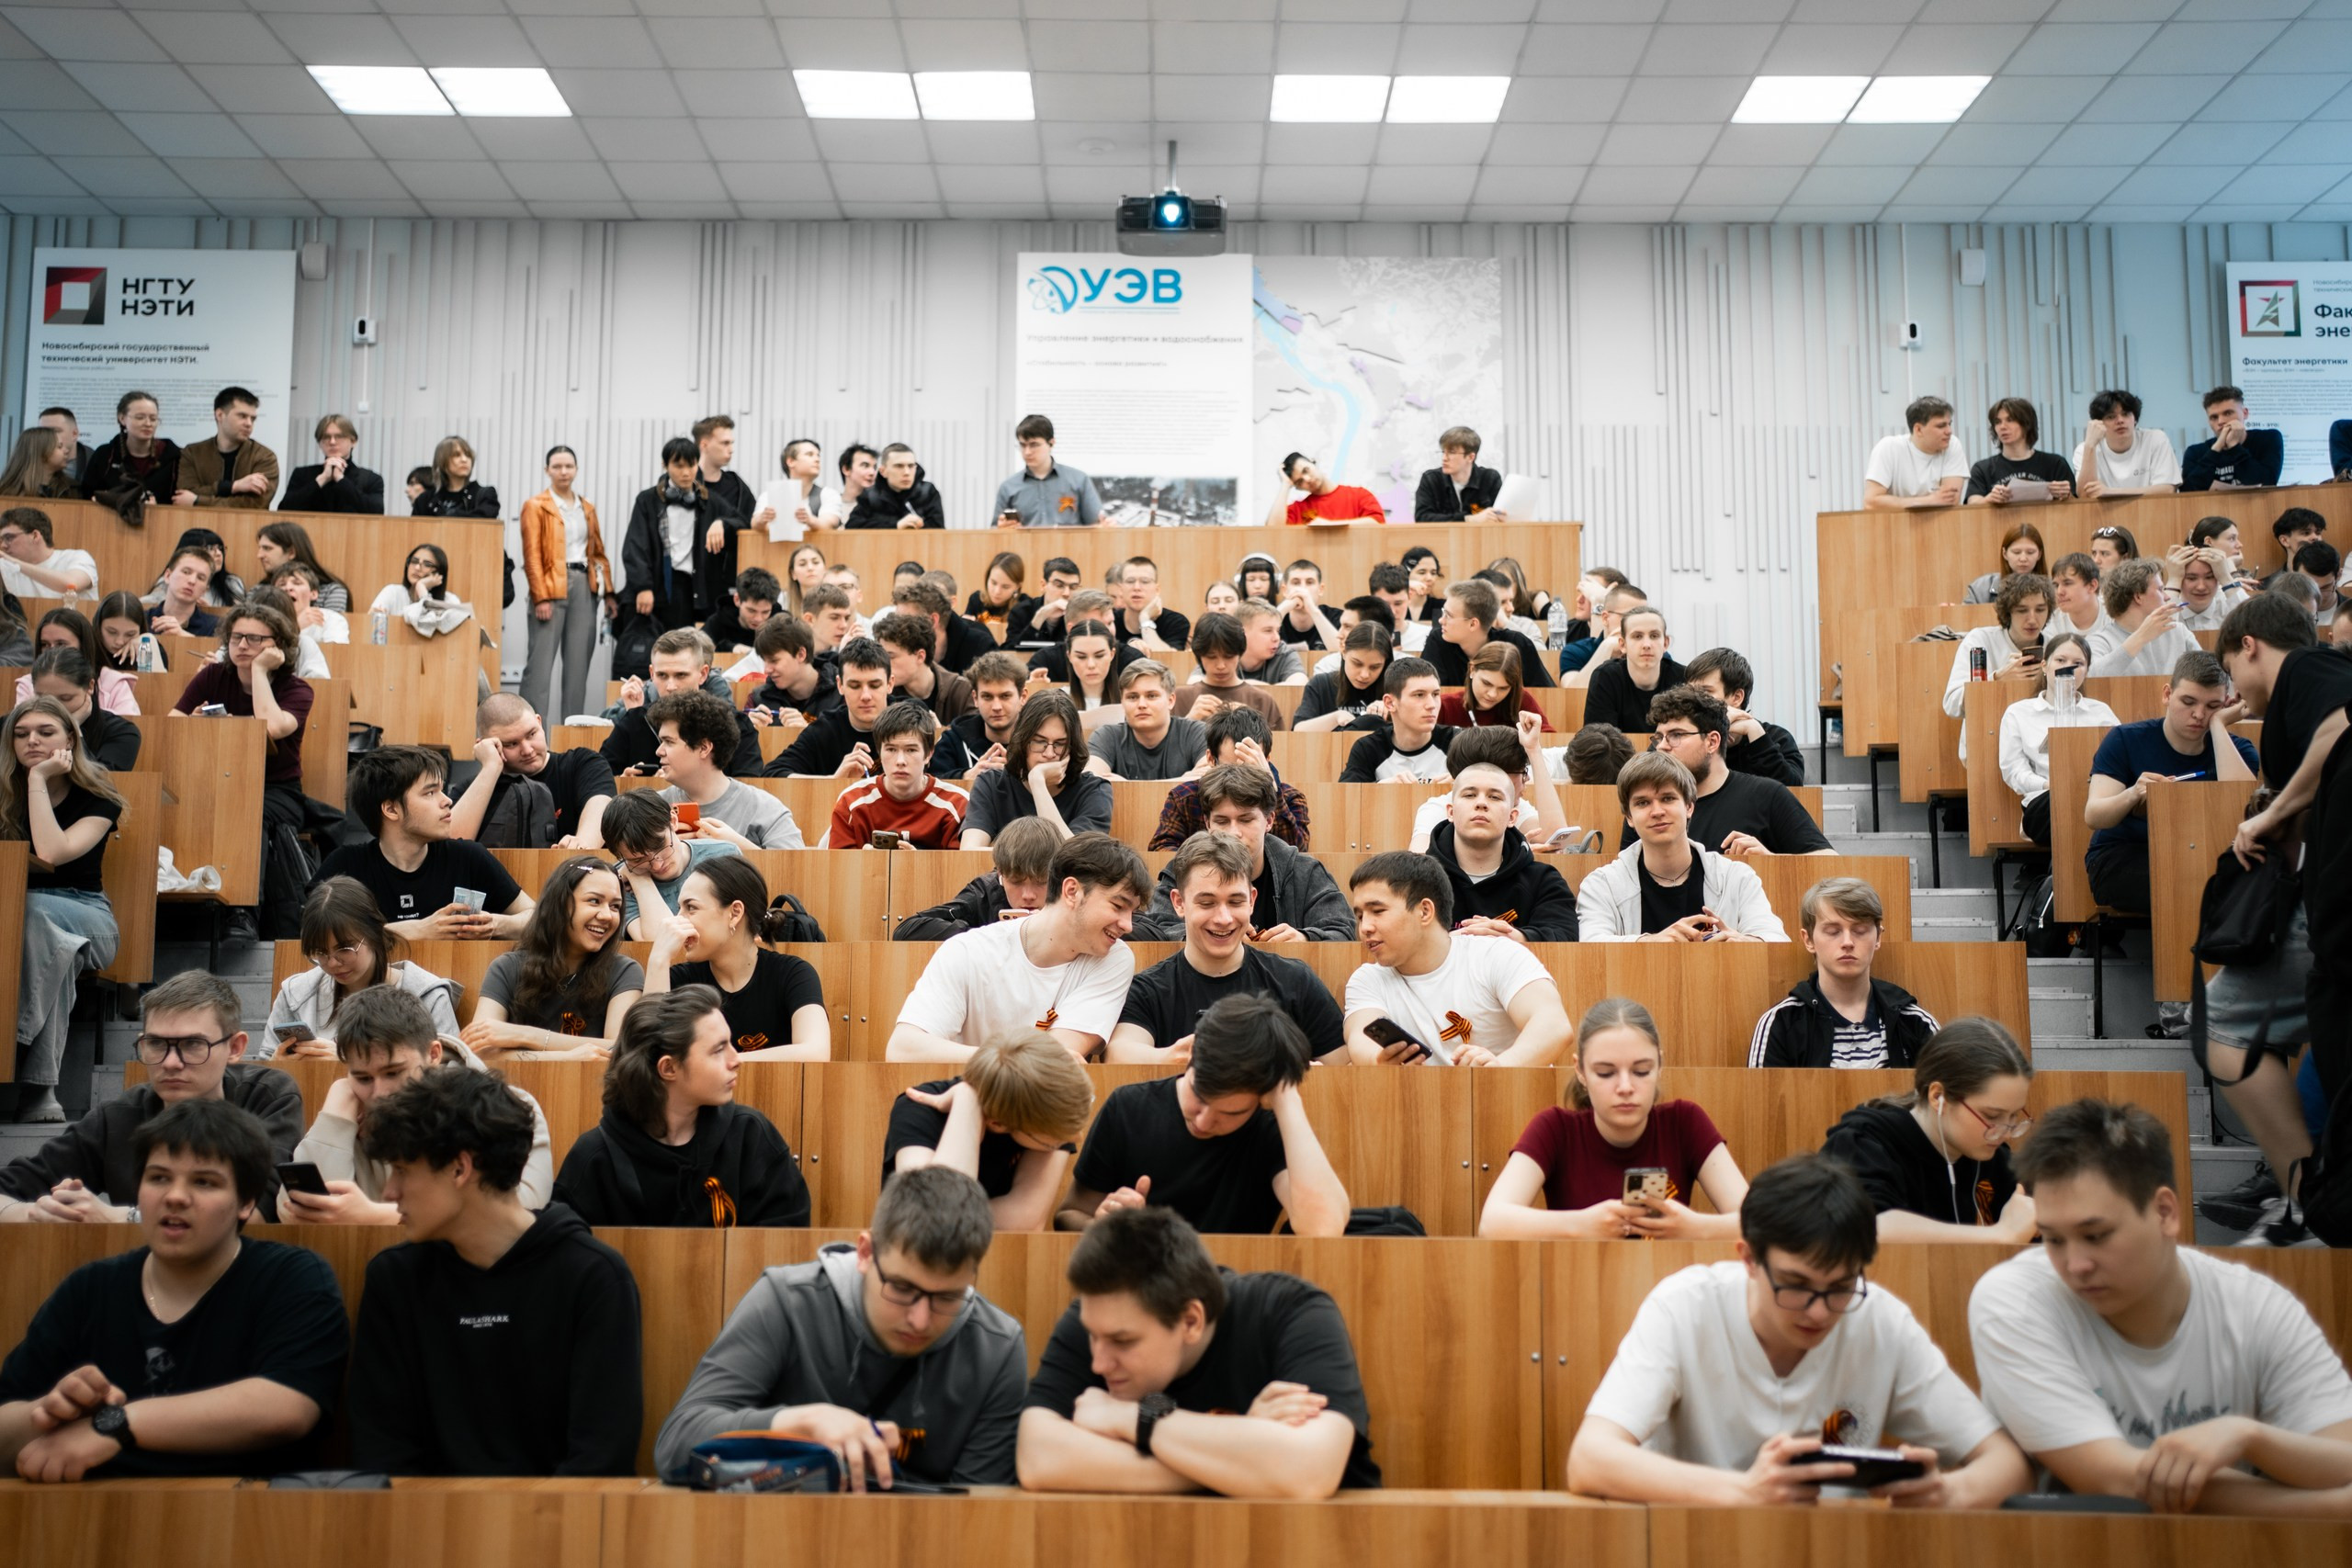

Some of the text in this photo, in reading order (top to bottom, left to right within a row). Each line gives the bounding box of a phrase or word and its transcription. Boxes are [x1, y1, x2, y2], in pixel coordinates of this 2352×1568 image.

[122, 278, 195, 294] НГТУ
[1080, 268, 1182, 303] УЭВ
[121, 299, 194, 315] НЭТИ
[2314, 303, 2352, 318] Фак
[2315, 326, 2351, 337] эне
[41, 342, 210, 352] Новосибирский государственный
[41, 355, 103, 364] технический
[106, 356, 168, 365] университет
[2242, 357, 2347, 367] Факультет энергетики
